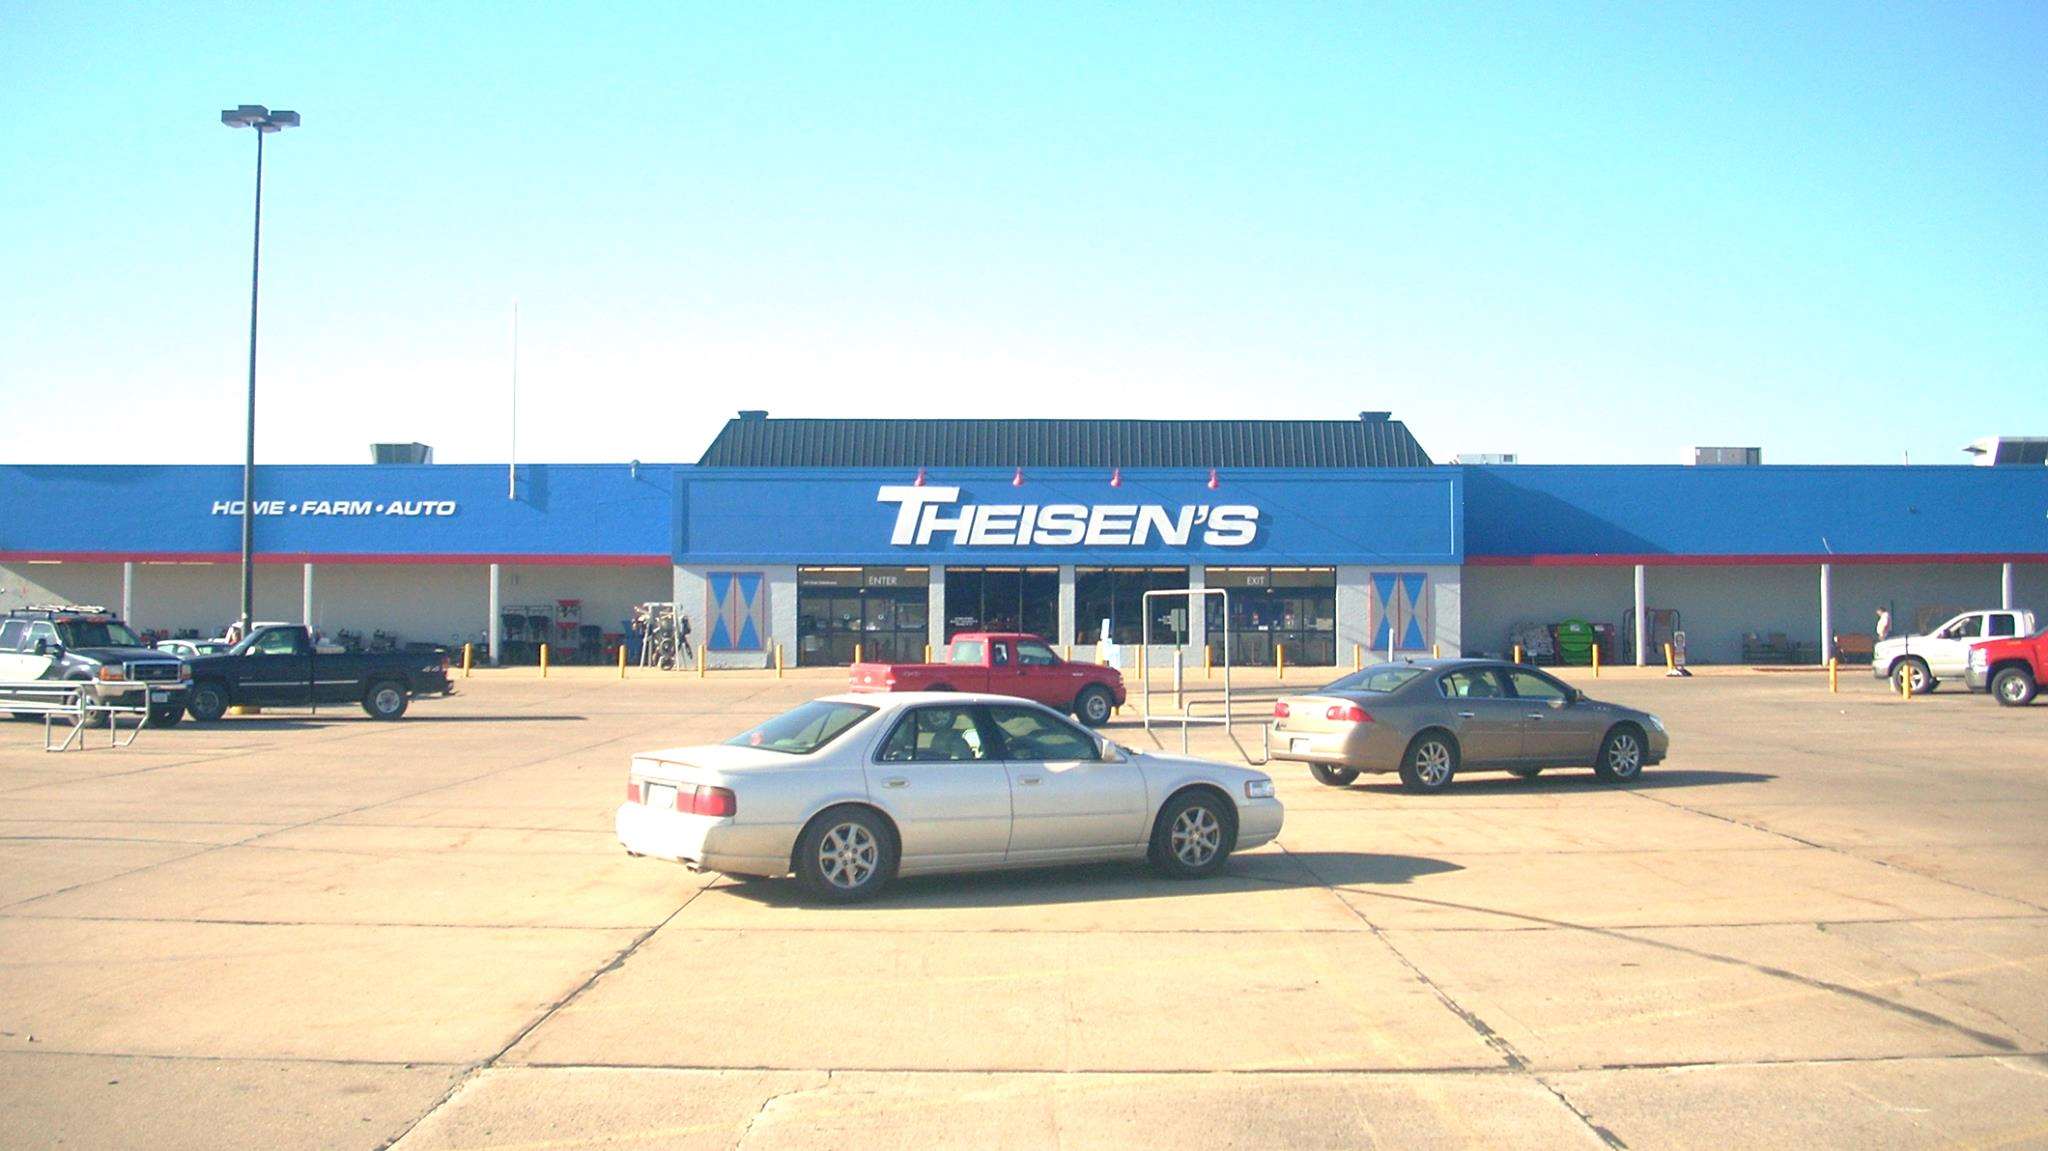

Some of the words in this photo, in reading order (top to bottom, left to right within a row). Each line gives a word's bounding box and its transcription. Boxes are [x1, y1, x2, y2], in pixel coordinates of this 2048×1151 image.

[300, 500, 371, 516] FARM
[385, 500, 456, 516] AUTO
[876, 485, 1260, 546] THEISEN'S
[868, 575, 898, 586] ENTER
[1246, 575, 1265, 586] EXIT
